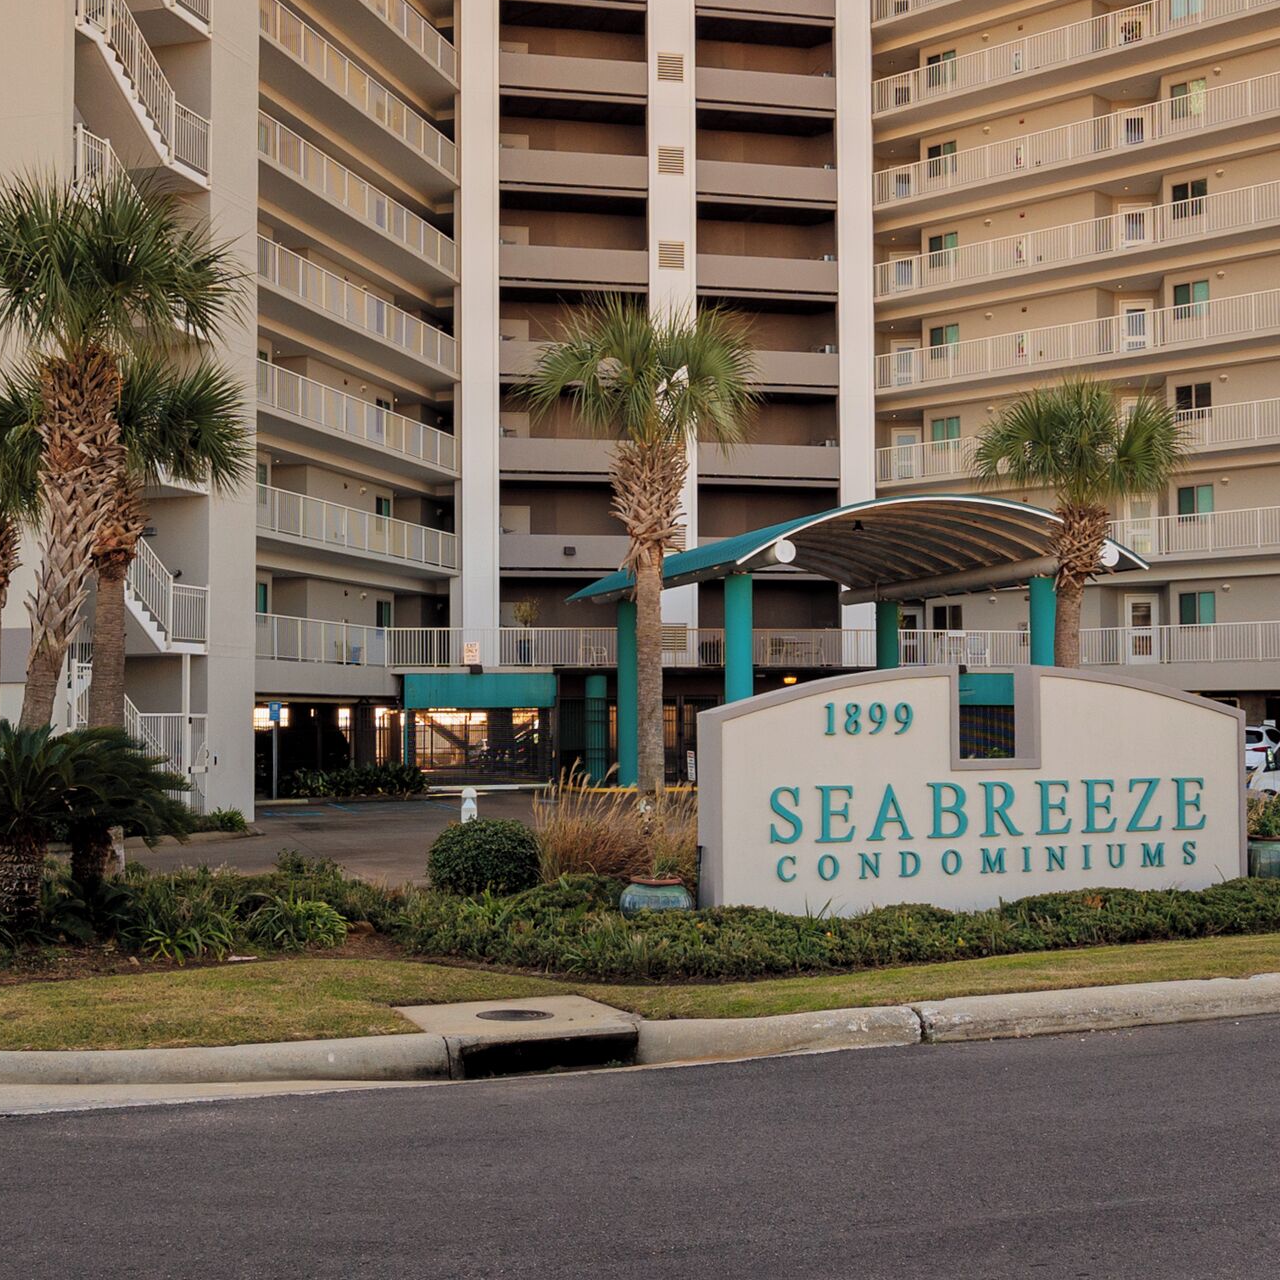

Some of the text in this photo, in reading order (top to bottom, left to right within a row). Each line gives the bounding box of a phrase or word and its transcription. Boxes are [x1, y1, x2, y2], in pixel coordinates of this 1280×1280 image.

[824, 701, 914, 735] 1899
[769, 775, 1207, 843] SEABREEZE
[776, 839, 1198, 882] CONDOMINIUMS
